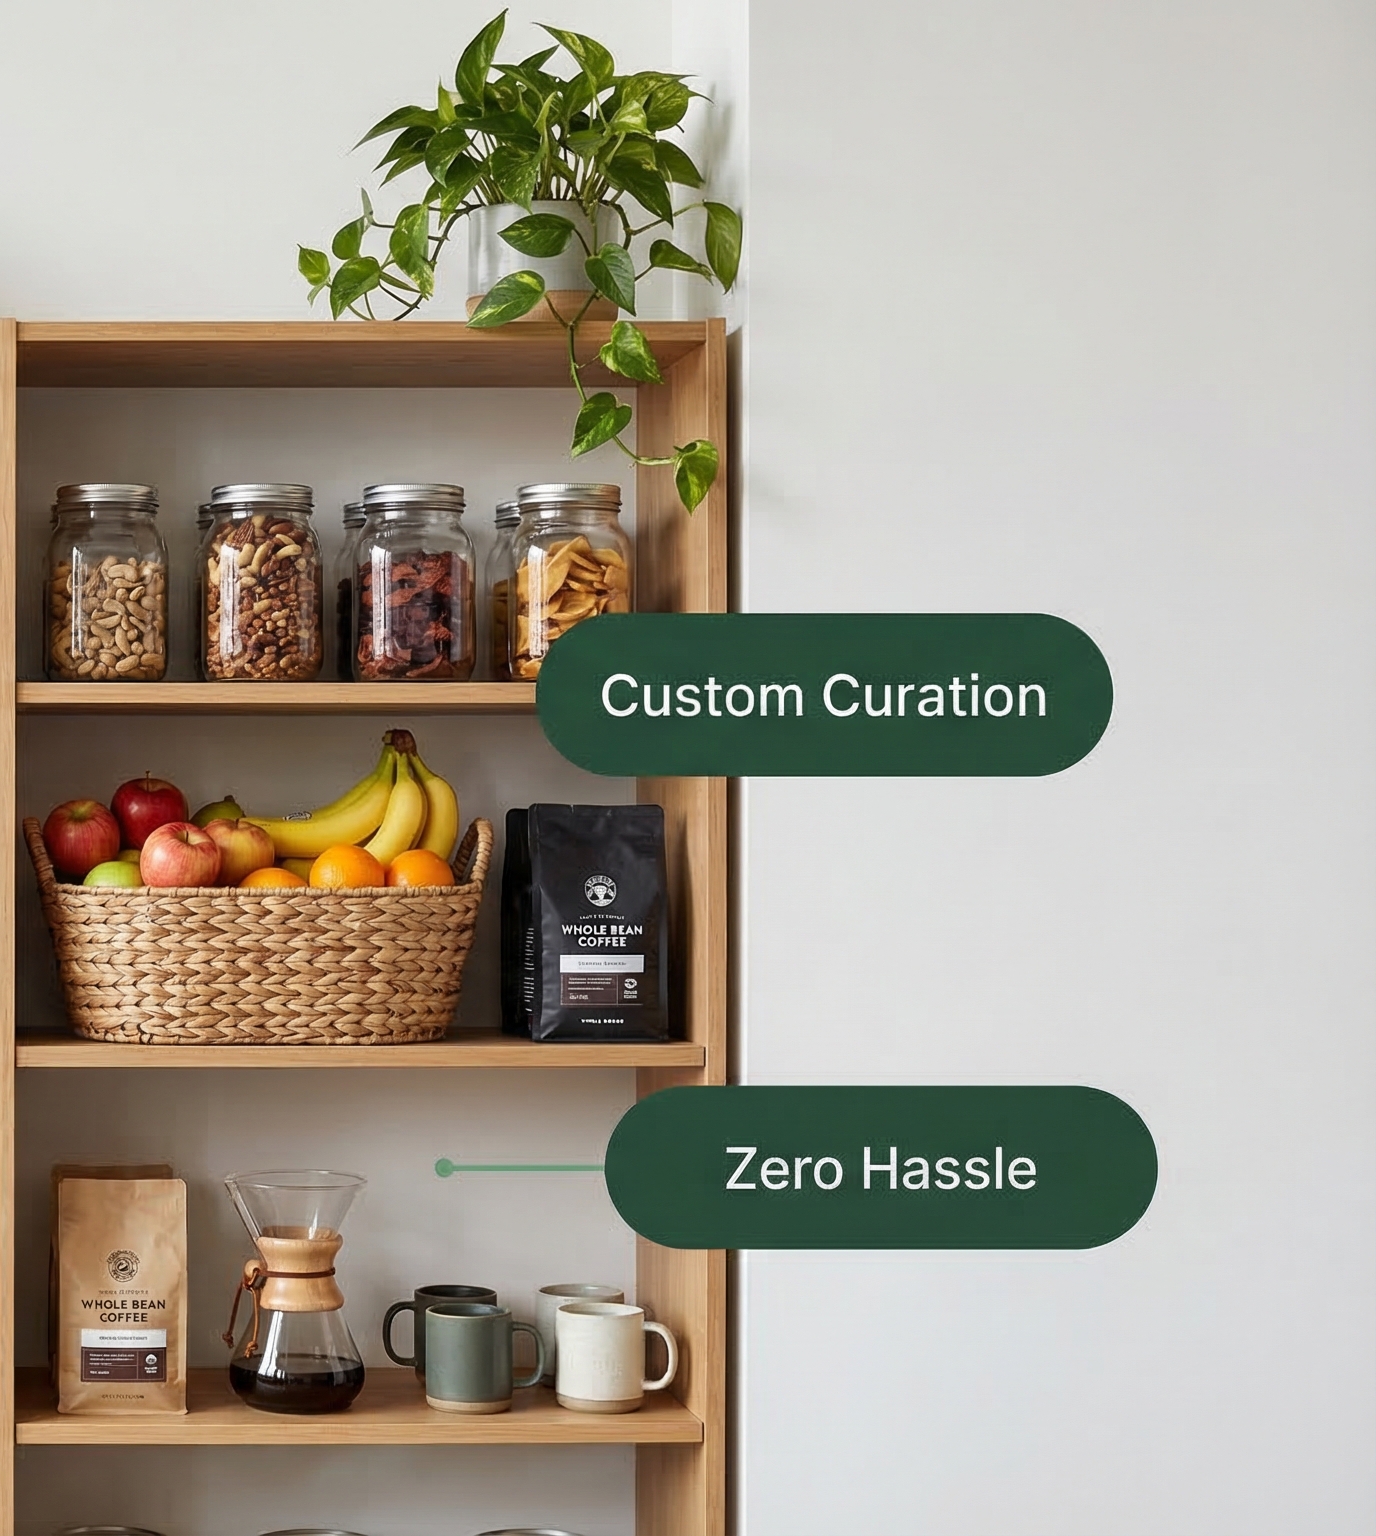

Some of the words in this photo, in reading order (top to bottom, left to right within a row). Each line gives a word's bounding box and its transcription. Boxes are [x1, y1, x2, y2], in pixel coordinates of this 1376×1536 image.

[561, 924, 607, 936] WHOLE
[610, 924, 643, 936] BEAN
[577, 936, 627, 948] COFFEE
[80, 1299, 128, 1310] WHOLE
[132, 1299, 166, 1310] BEAN
[99, 1312, 148, 1323] COFFEE
